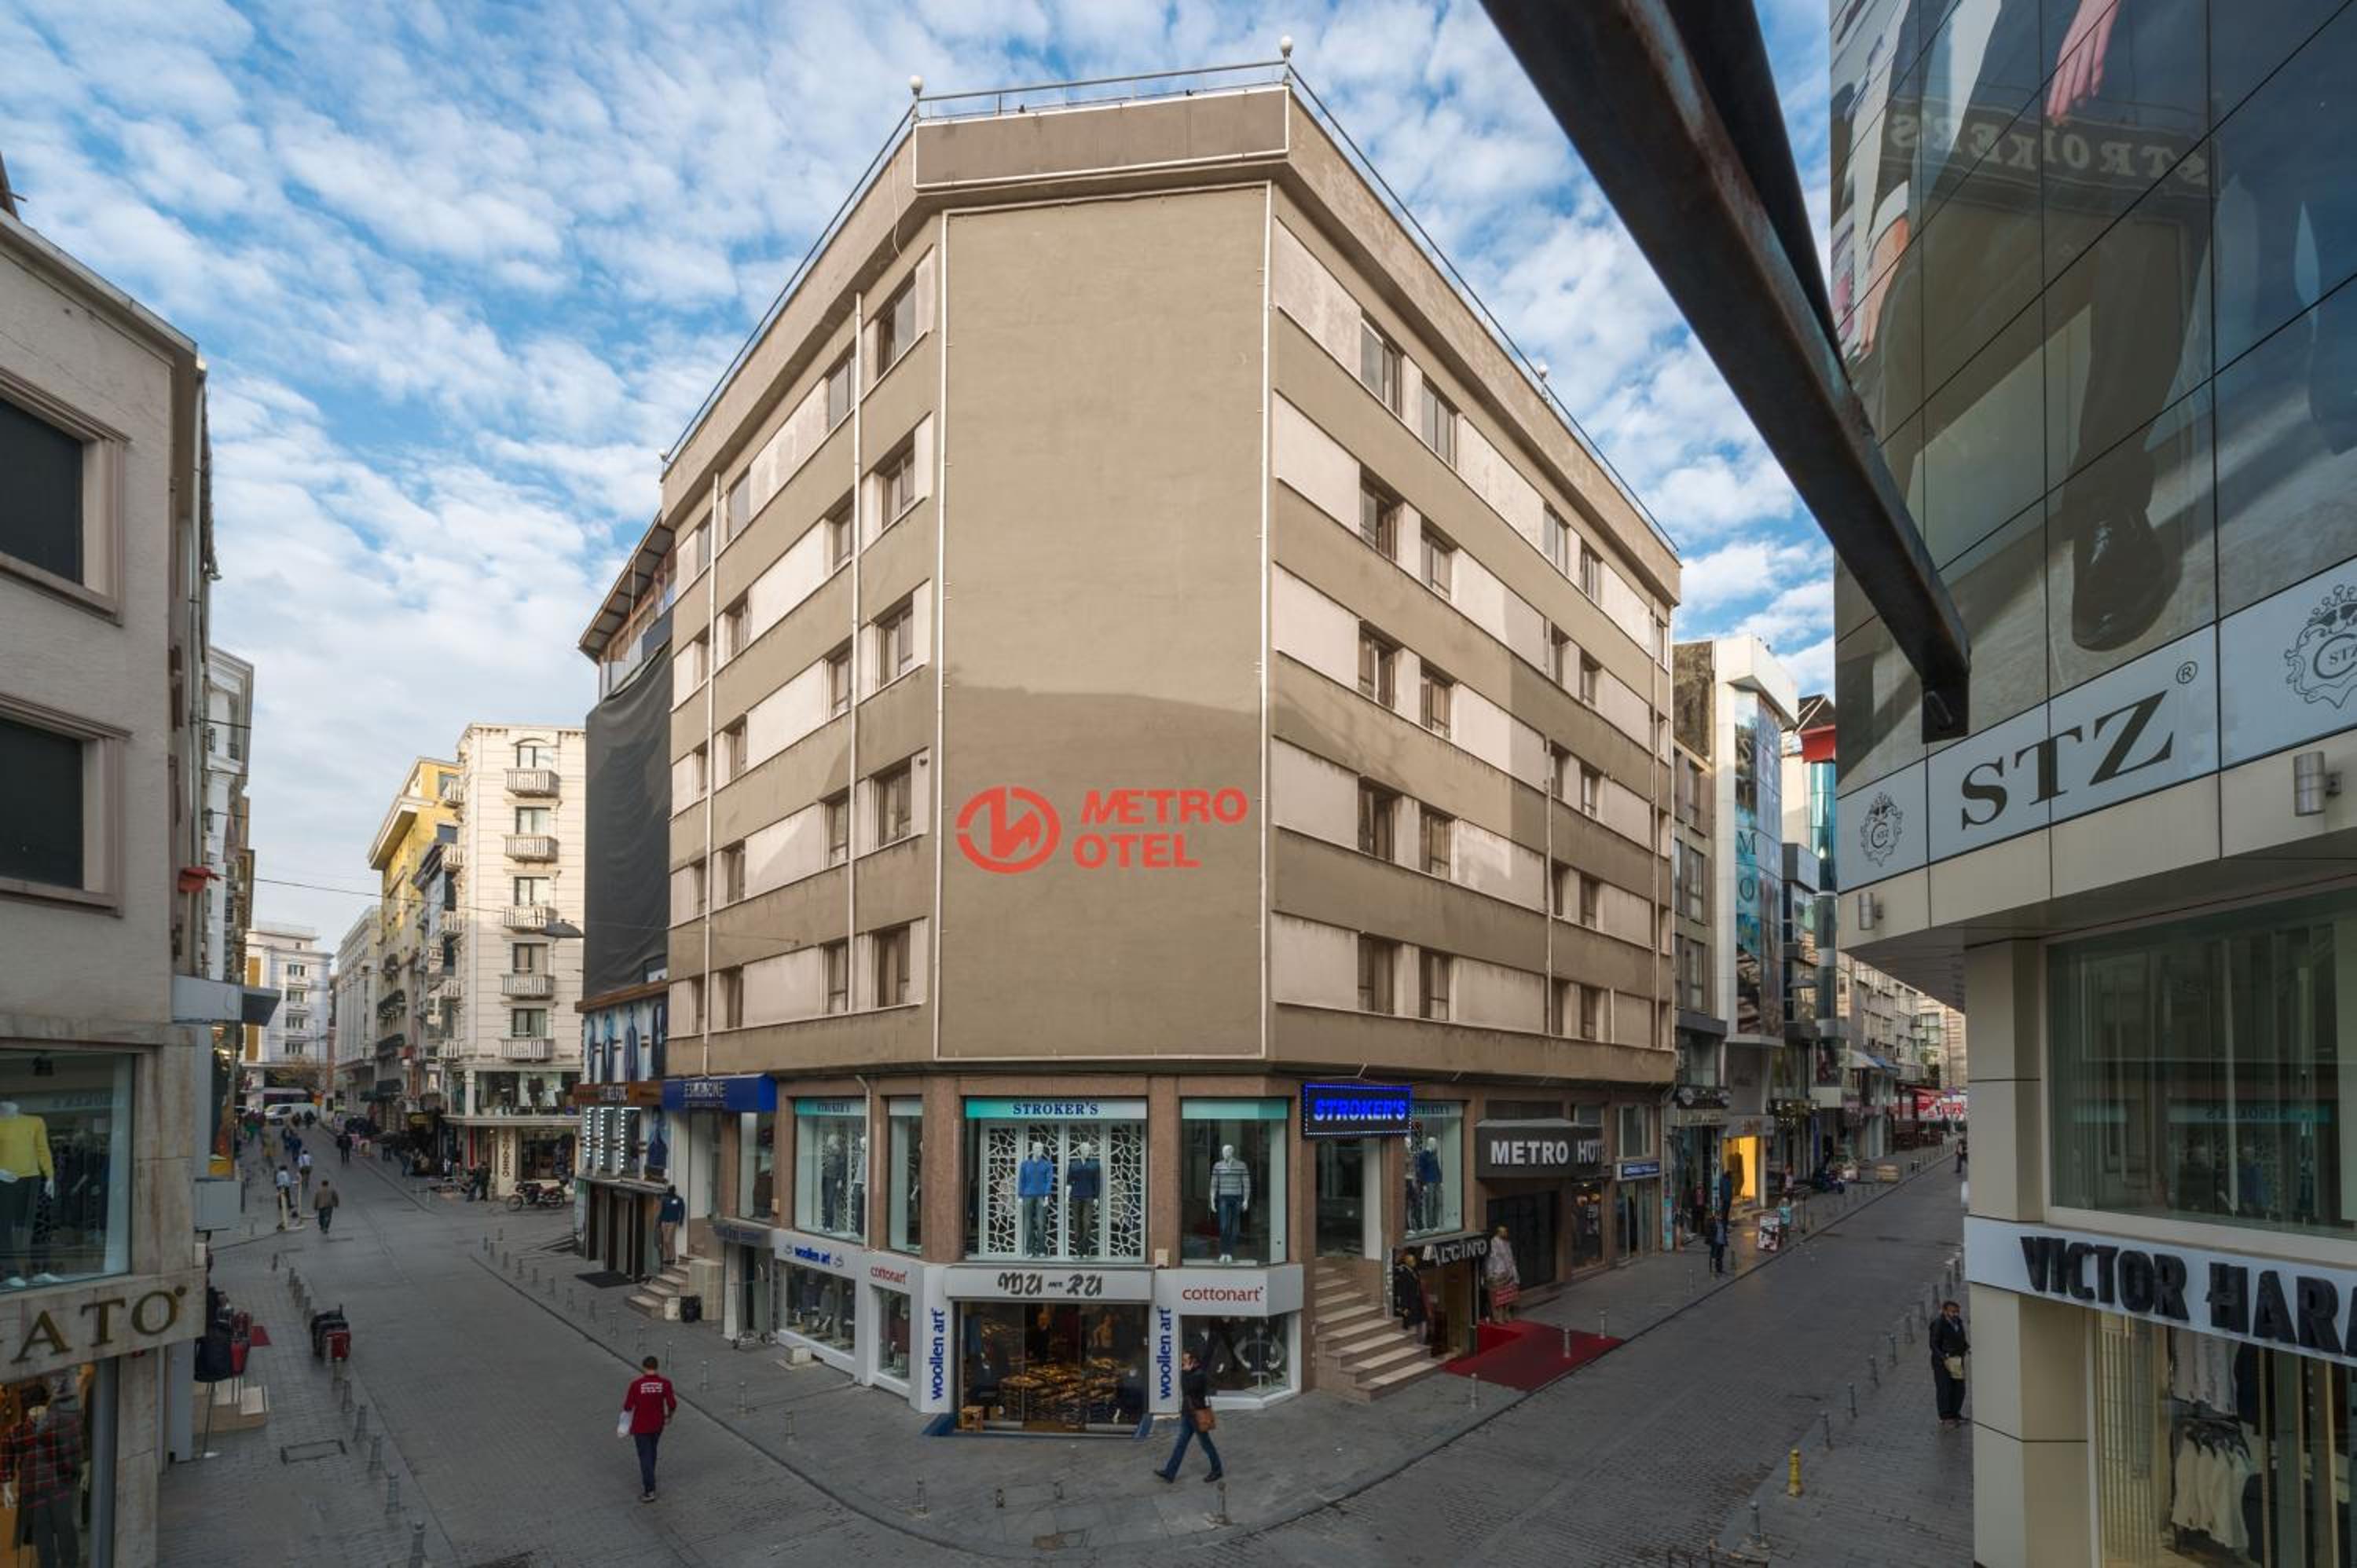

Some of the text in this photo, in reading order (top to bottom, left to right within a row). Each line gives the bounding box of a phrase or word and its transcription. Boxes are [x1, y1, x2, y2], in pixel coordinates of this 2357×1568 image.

[1960, 689, 2175, 831] STZ
[1080, 786, 1249, 826] METRO
[1072, 833, 1204, 869] OTEL
[1013, 1101, 1098, 1116] STROKER'S
[1313, 1097, 1406, 1121] STROKER'S
[1490, 1140, 1570, 1165] METRO
[870, 1265, 908, 1284] cottonart
[1182, 1286, 1260, 1302] cottonart
[2020, 1236, 2357, 1358] VICTOR HAR
[0, 1289, 178, 1365] ATO
[929, 1308, 945, 1401] woollen art
[1157, 1307, 1172, 1401] woollen art
